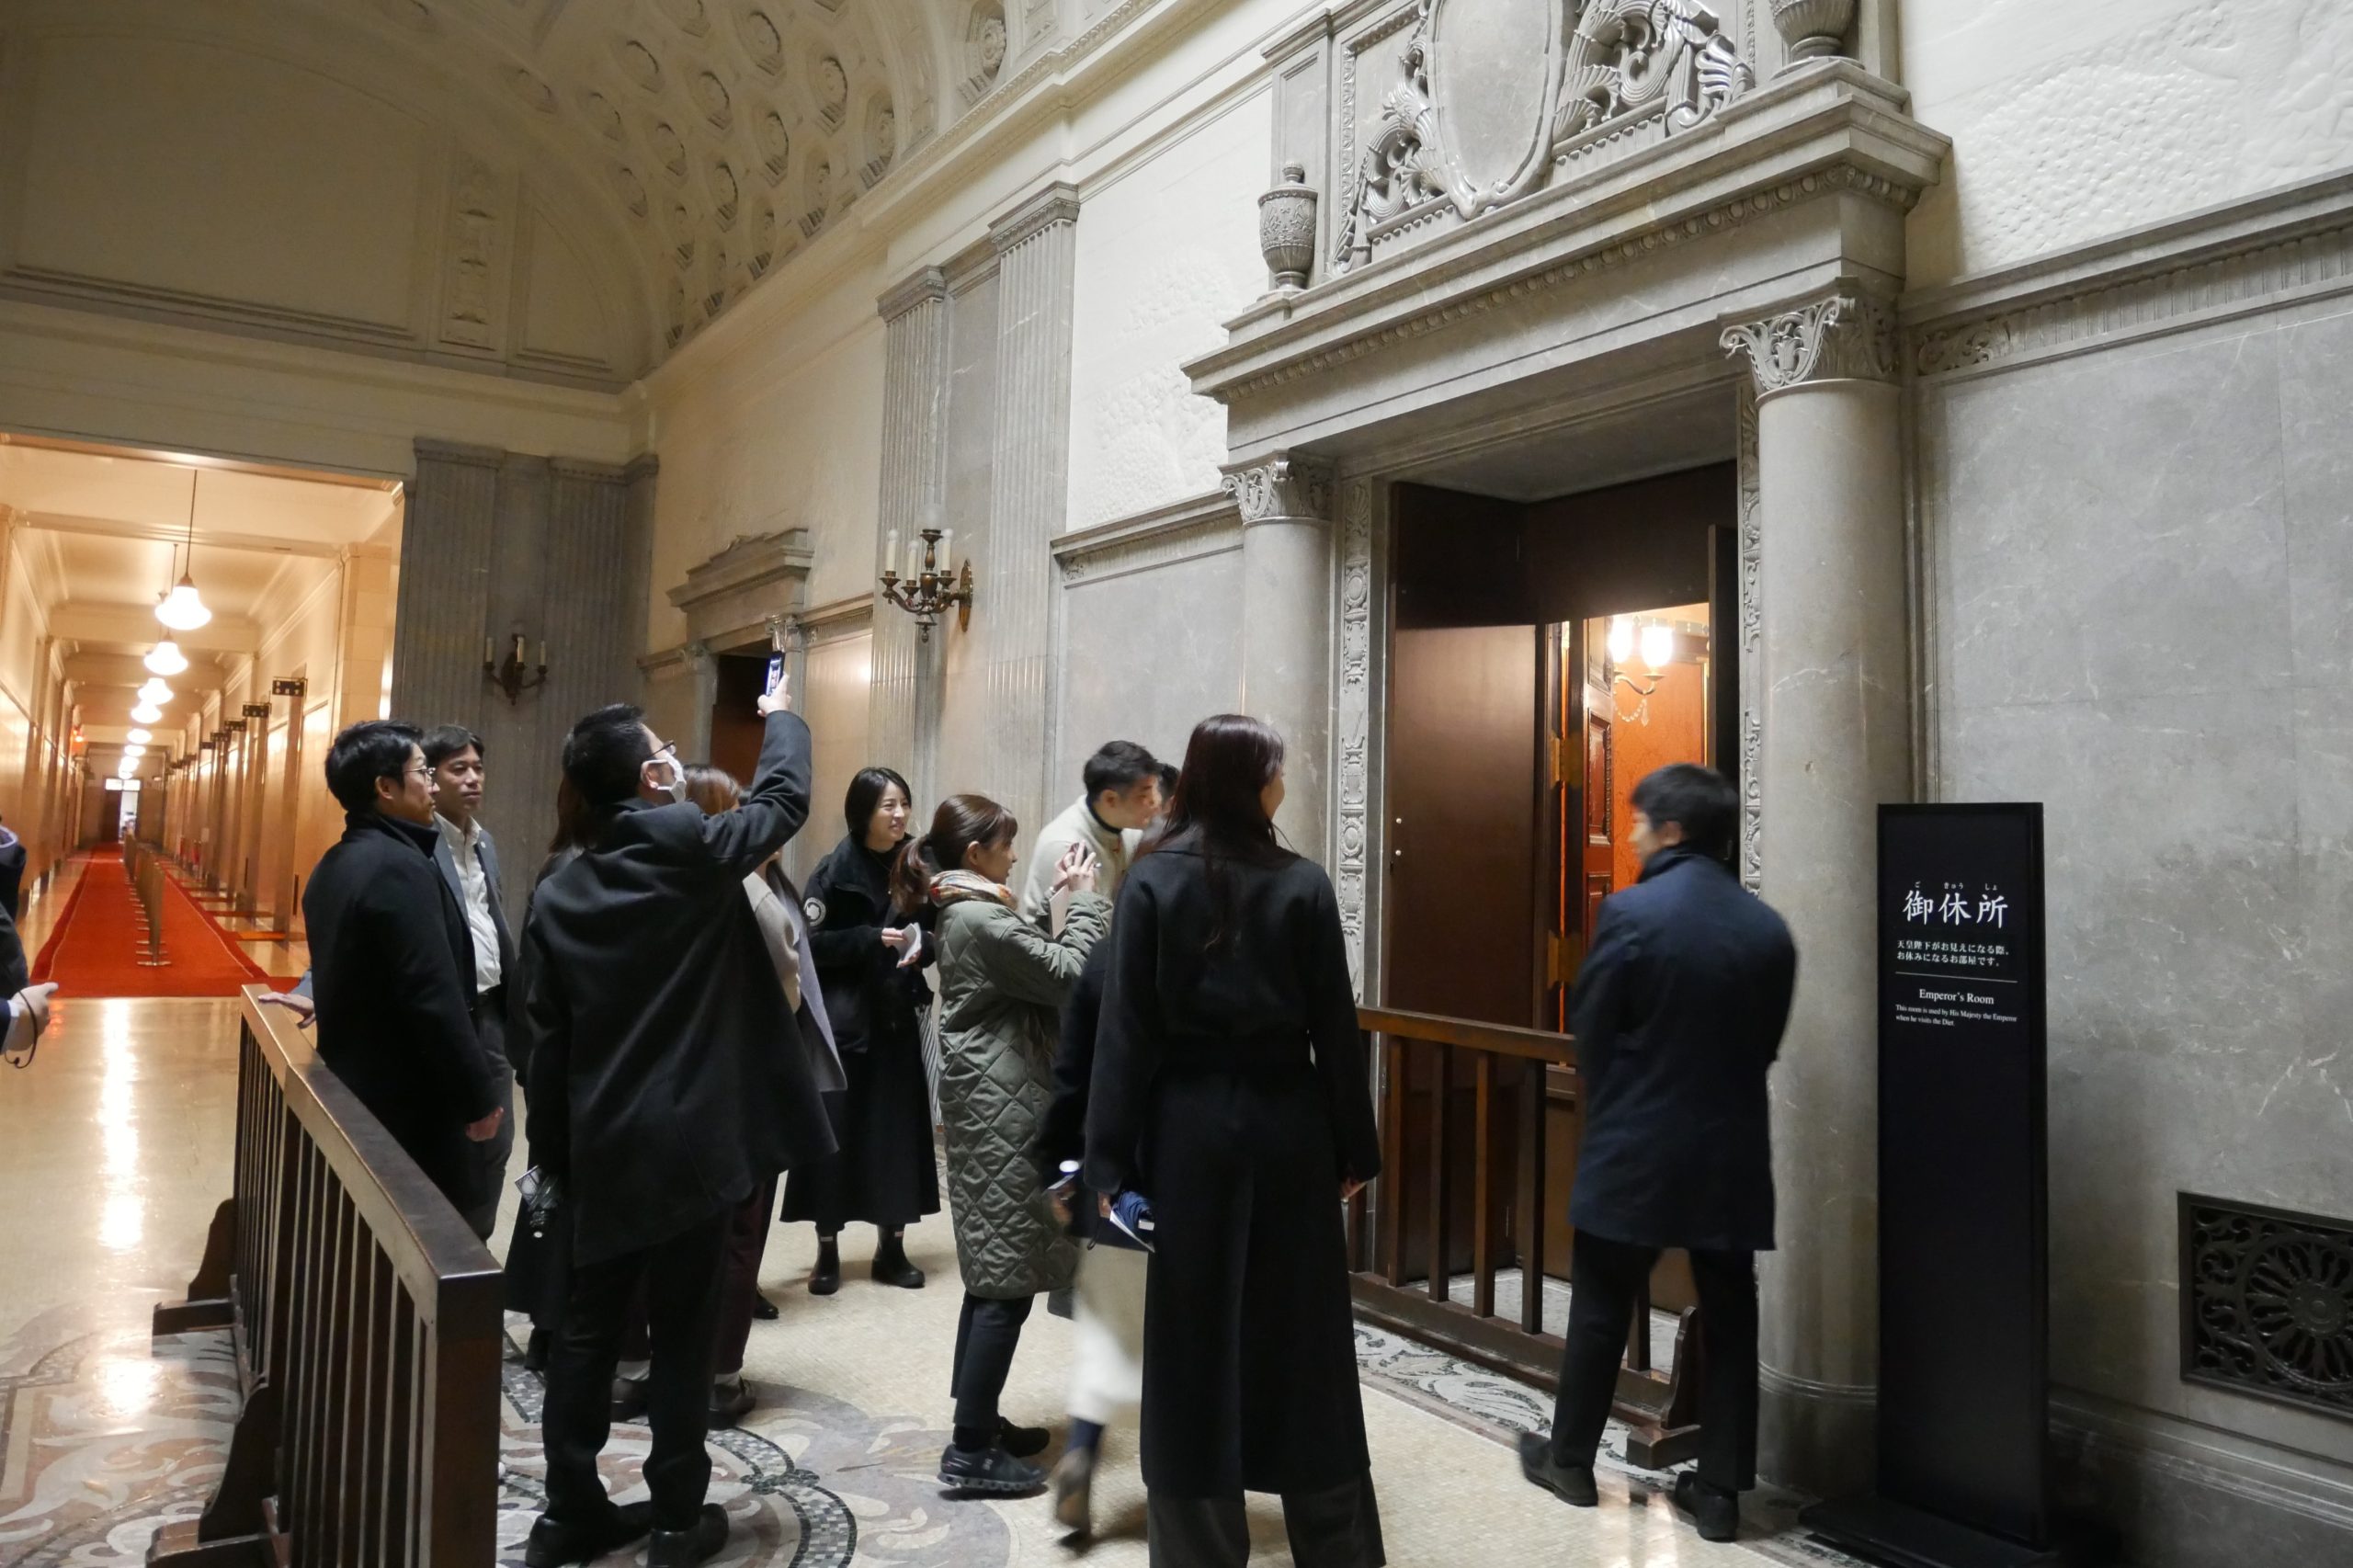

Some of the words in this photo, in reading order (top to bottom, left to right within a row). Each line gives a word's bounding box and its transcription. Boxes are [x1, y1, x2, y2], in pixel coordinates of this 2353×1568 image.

[1903, 890, 2008, 928] 御休所
[1967, 993, 1995, 1005] Room
[1941, 1008, 1948, 1017] by
[1961, 1010, 1982, 1019] Majesty
[1993, 1014, 2018, 1022] Emperor
